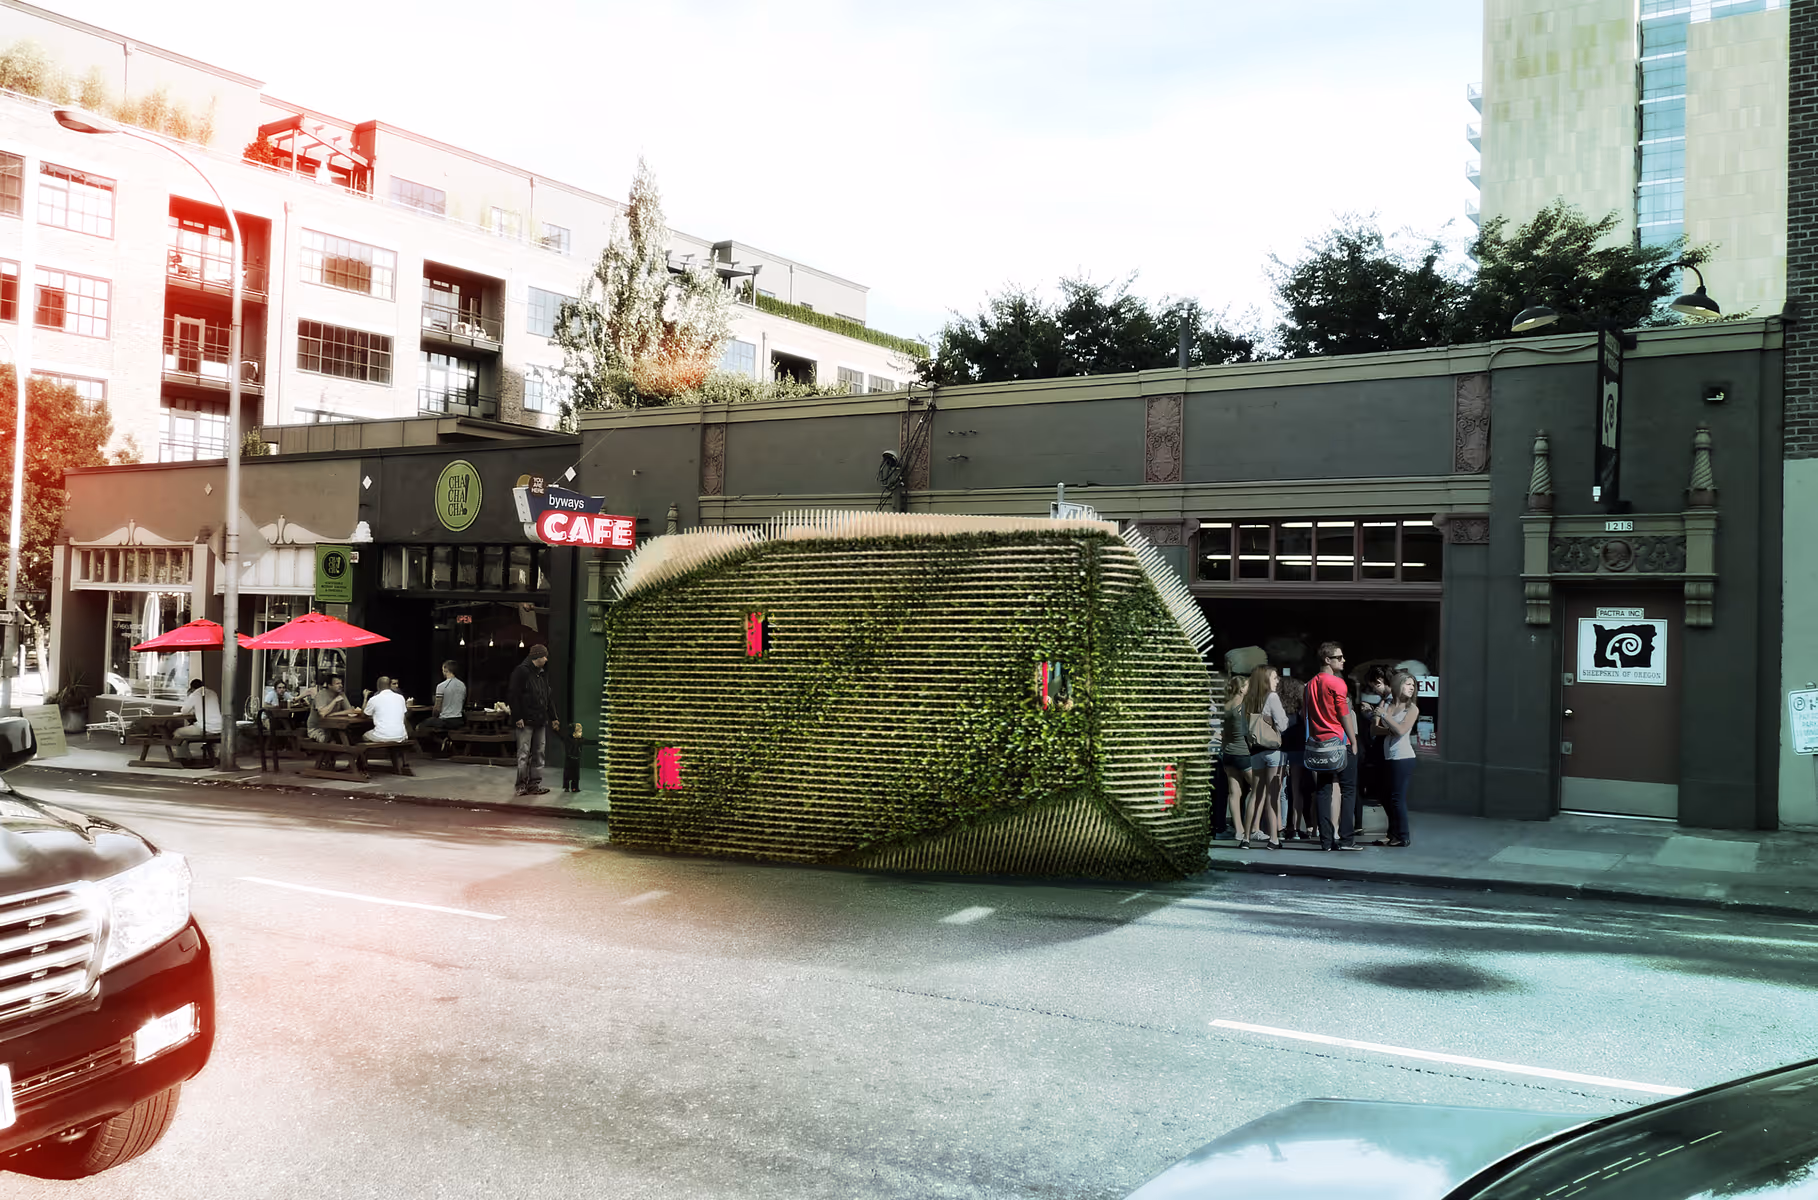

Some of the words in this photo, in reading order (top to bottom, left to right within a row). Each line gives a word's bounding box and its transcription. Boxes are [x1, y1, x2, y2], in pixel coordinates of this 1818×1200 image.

[448, 475, 466, 489] CHA
[448, 489, 466, 503] CHA
[549, 494, 585, 510] byways
[543, 513, 633, 546] CAFE
[1607, 522, 1632, 530] 1218
[1582, 669, 1620, 677] SHEEPSKIN
[1417, 680, 1436, 692] EN
